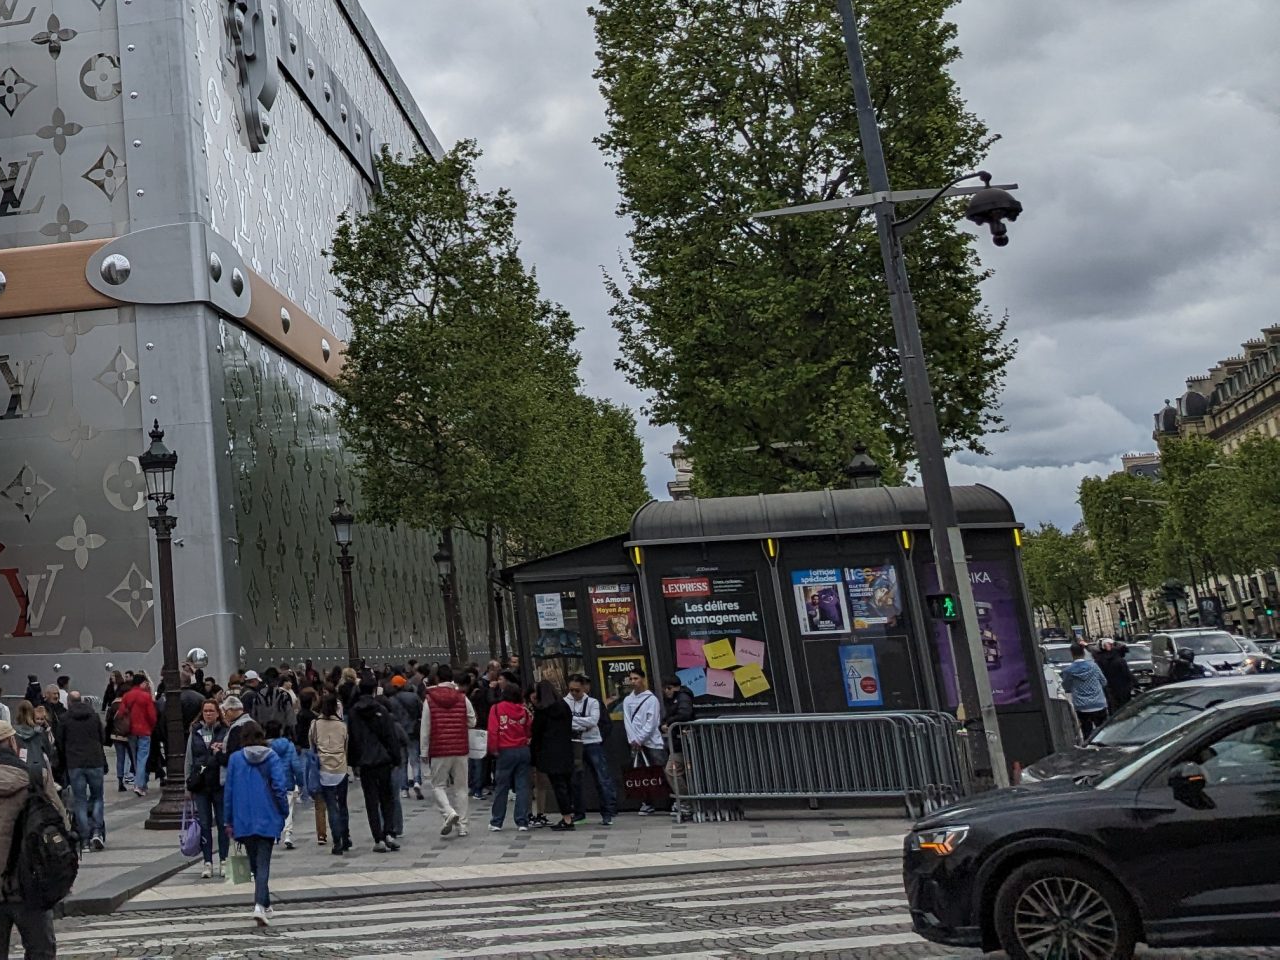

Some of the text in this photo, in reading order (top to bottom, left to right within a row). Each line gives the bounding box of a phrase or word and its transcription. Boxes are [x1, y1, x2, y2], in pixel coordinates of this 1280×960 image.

[684, 599, 739, 613] Les délires
[670, 610, 758, 625] du management
[626, 777, 663, 788] GUCCI
